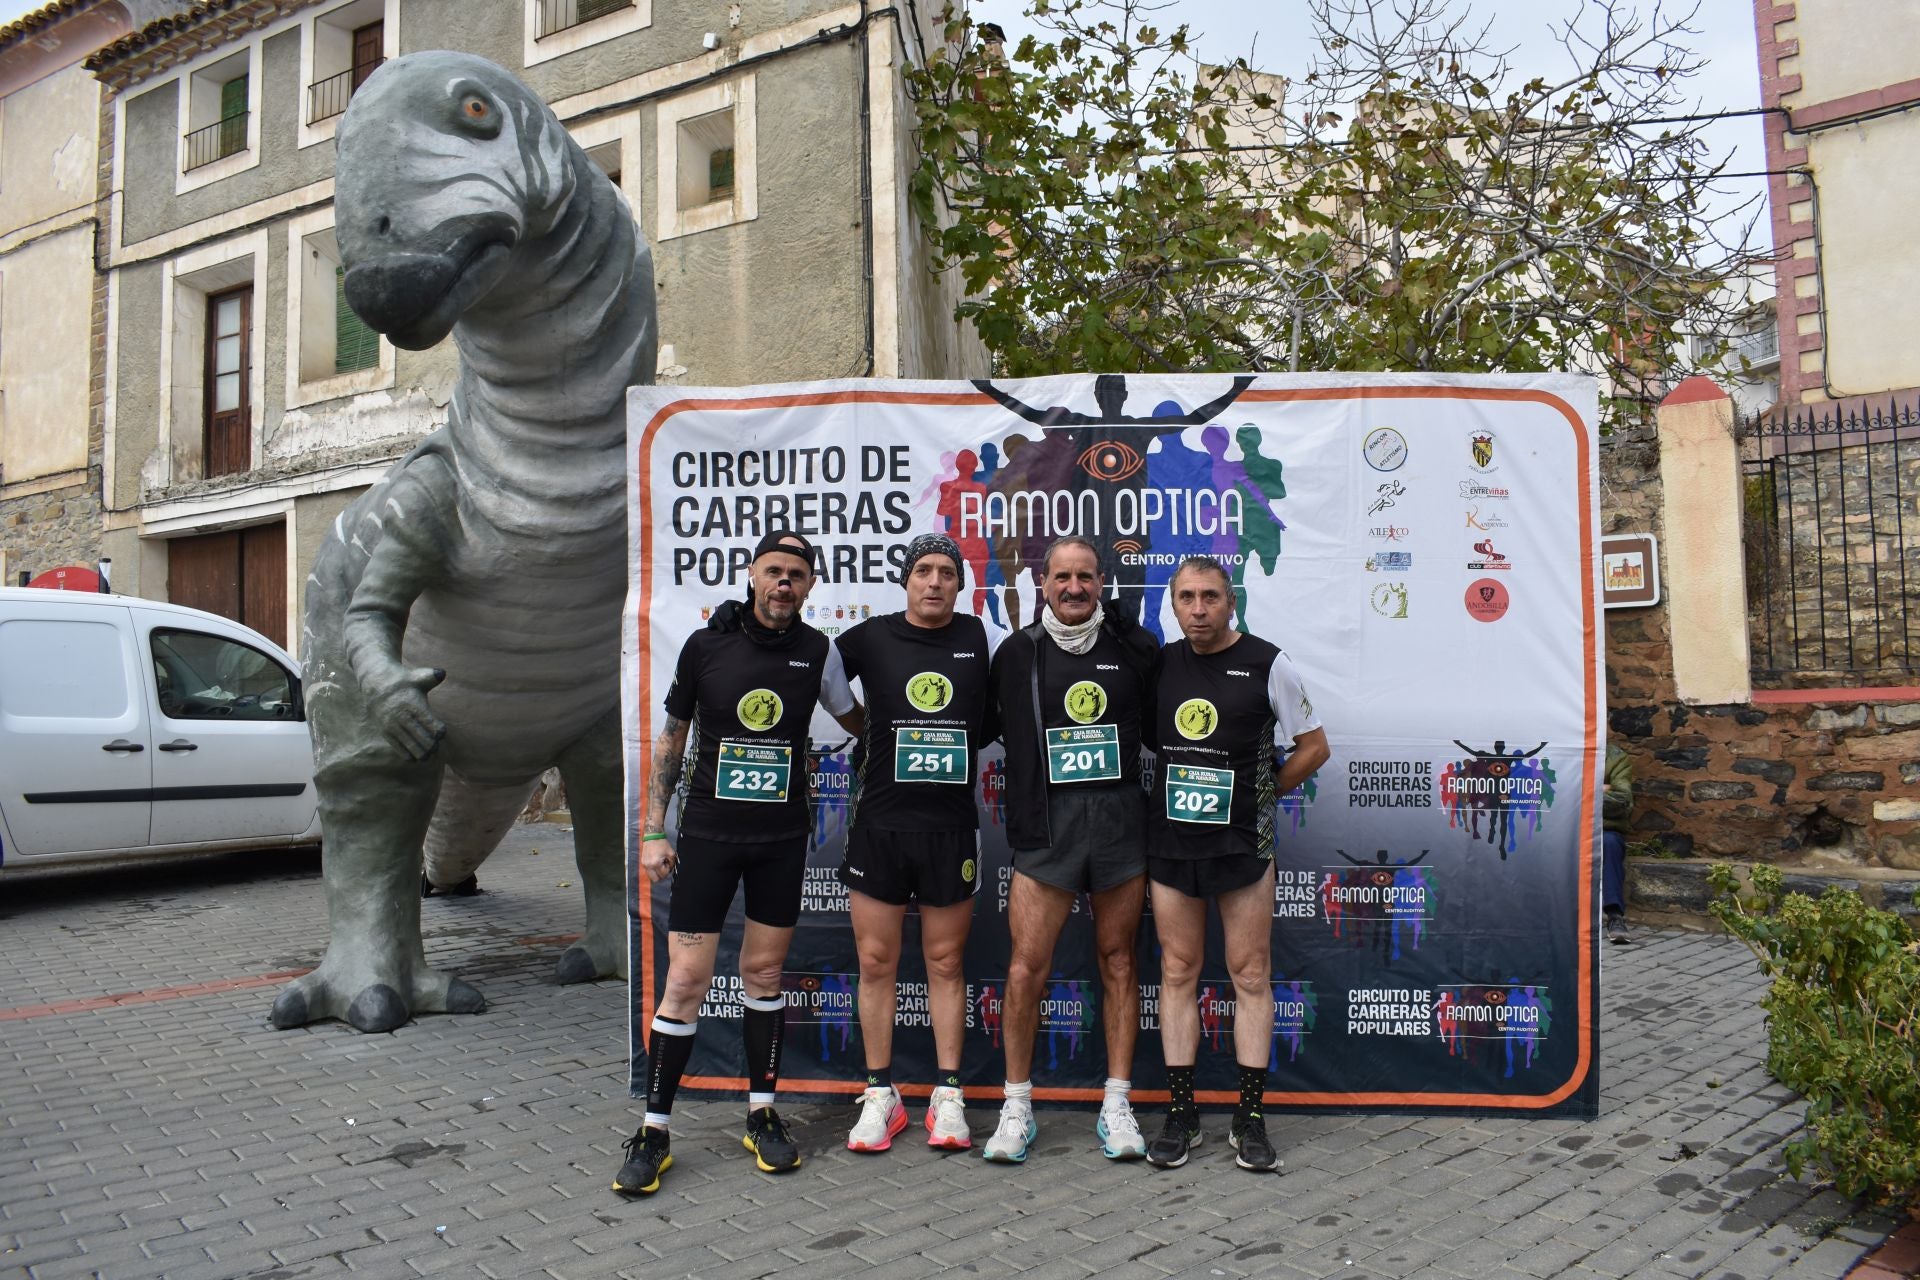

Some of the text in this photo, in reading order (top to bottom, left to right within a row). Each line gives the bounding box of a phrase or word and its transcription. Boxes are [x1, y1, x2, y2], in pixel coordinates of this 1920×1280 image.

[1369, 432, 1388, 450] RINCON
[1379, 445, 1403, 468] ATLETISMO
[672, 446, 911, 488] CIRCUITO DE
[672, 491, 912, 538] CARRERAS
[960, 488, 1243, 538] RAMON OPTICA
[674, 544, 909, 586] POPARES
[1121, 554, 1176, 566] CENTRO
[908, 753, 953, 773] 251
[1061, 750, 1105, 772] 201
[1349, 761, 1432, 775] CIRCUITO DE
[729, 769, 778, 791] 232
[809, 772, 850, 789] OPTICA
[1349, 777, 1432, 792] CARRERAS
[1448, 777, 1542, 795] RAMON OPTICA
[1174, 790, 1219, 813] 202
[1349, 793, 1432, 808] POPULARES
[1298, 871, 1316, 884] DE
[1275, 886, 1316, 901] ERAS
[1331, 887, 1425, 904] RAMON OPTICA
[800, 898, 851, 911] PULARE
[781, 991, 853, 1008] MON OPTICA
[1349, 989, 1431, 1003] CIRCUITO DE
[699, 1005, 745, 1018] ULARES
[1040, 1000, 1082, 1016] OPTICA
[1210, 1001, 1236, 1016] RAM
[1348, 1004, 1431, 1019] CARRERAS
[1446, 1005, 1539, 1022] RAMON OPTICA
[1348, 1021, 1431, 1036] POPULARES
